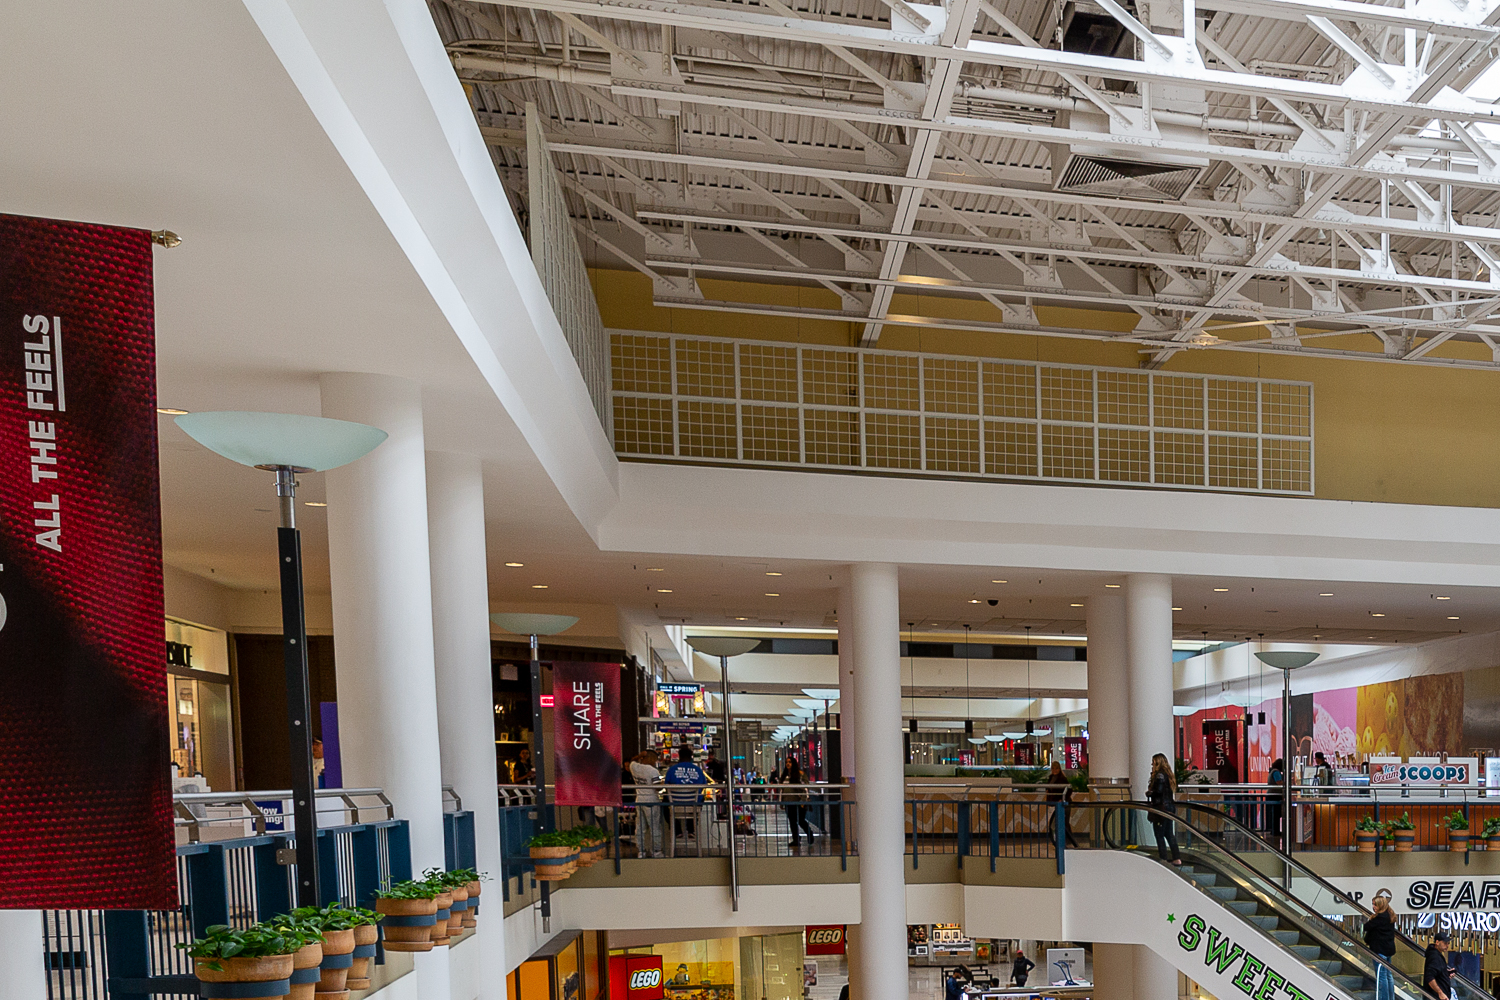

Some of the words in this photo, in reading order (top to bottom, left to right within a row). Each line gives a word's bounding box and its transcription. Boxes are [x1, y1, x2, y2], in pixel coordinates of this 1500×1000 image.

[23, 314, 54, 410] FEELS
[28, 420, 58, 483] THE
[34, 494, 62, 552] ALL
[572, 682, 591, 750] SHARE
[1216, 729, 1224, 766] SHARE
[1372, 770, 1400, 783] Cream
[1399, 766, 1466, 782] SCOOPS
[1382, 764, 1396, 773] Ice
[808, 928, 843, 946] LEGO
[630, 968, 661, 990] LEGO
